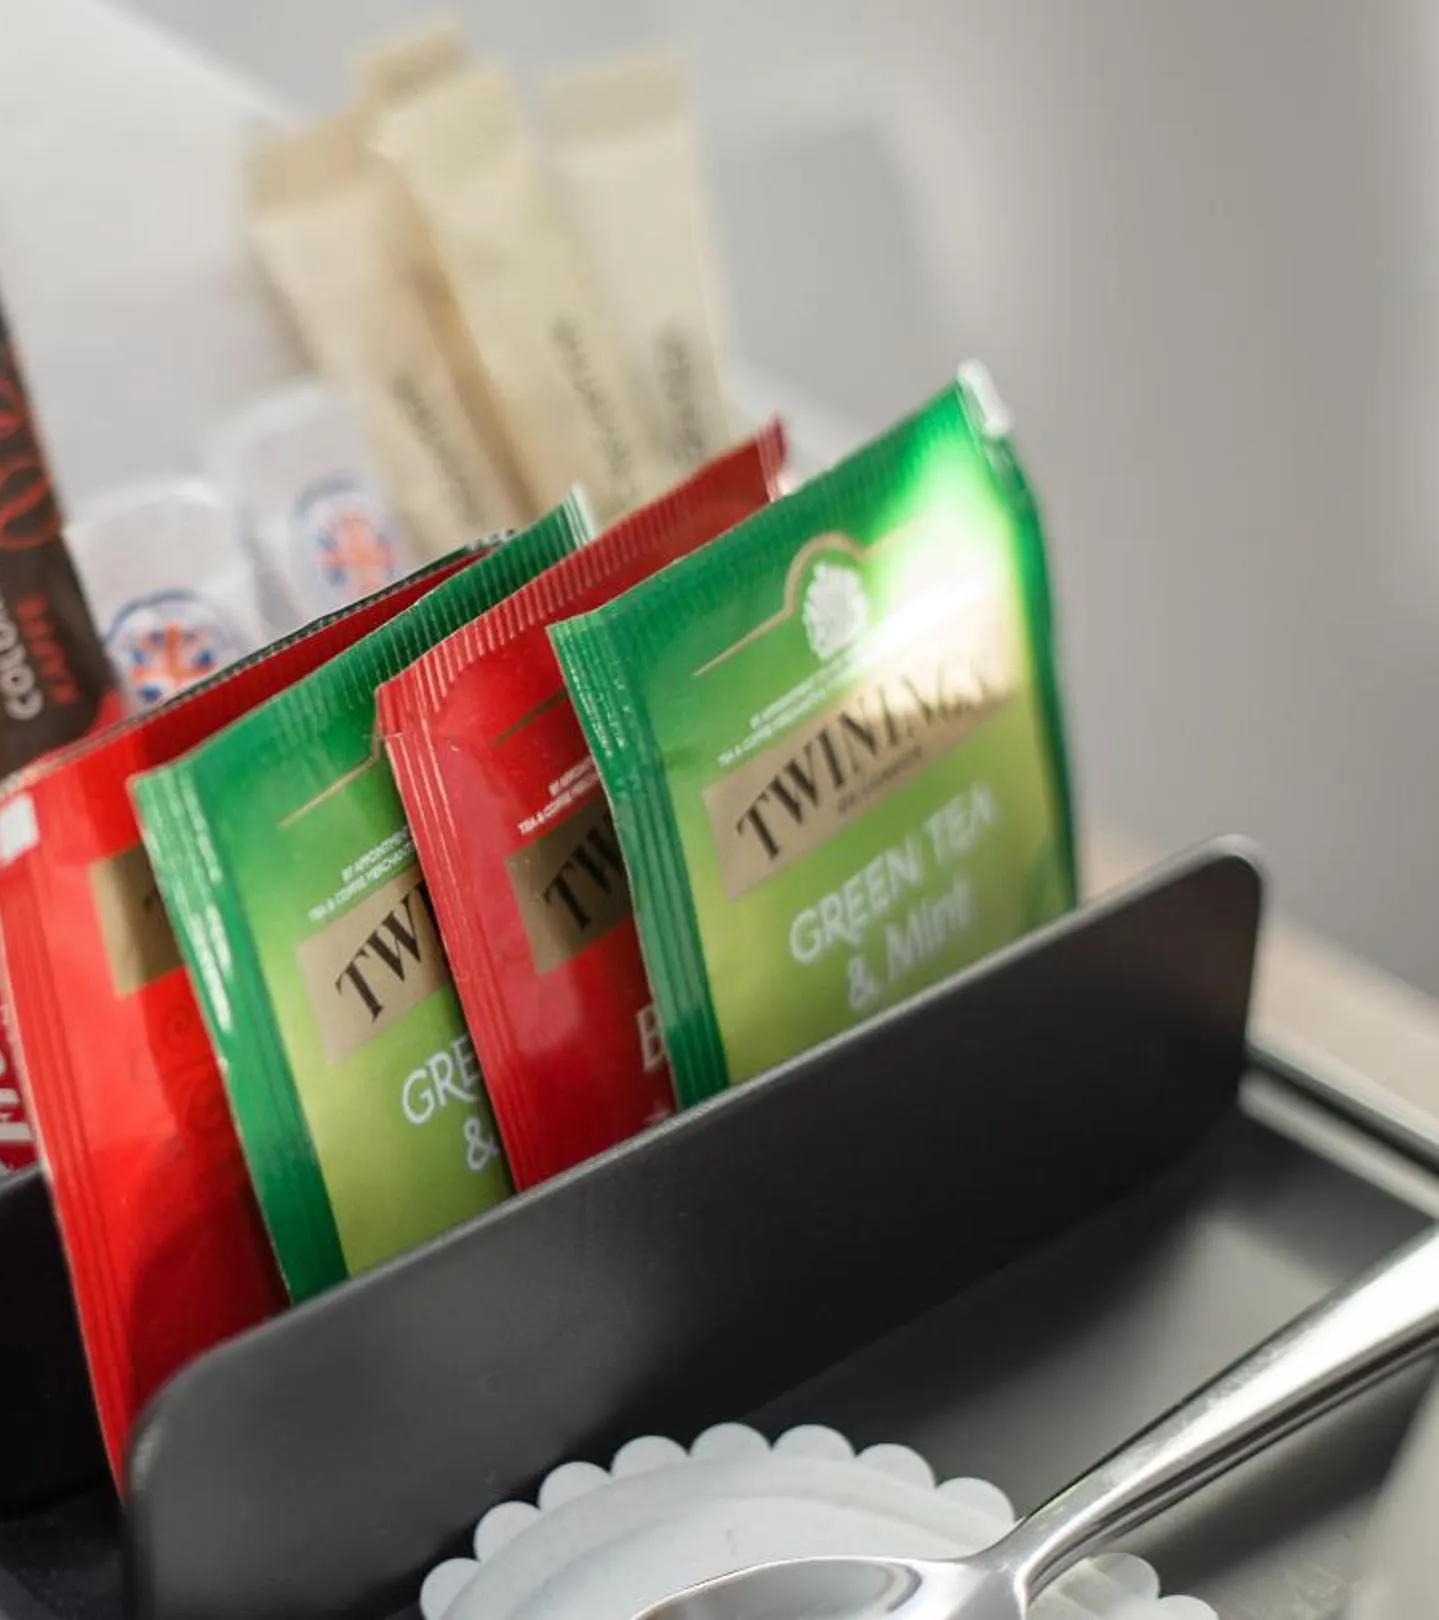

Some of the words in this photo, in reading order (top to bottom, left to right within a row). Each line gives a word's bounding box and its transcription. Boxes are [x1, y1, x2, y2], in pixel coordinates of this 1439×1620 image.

[789, 836, 923, 964] GREEN
[925, 785, 994, 866] TEA
[848, 956, 879, 1012] &
[464, 1116, 500, 1171] &
